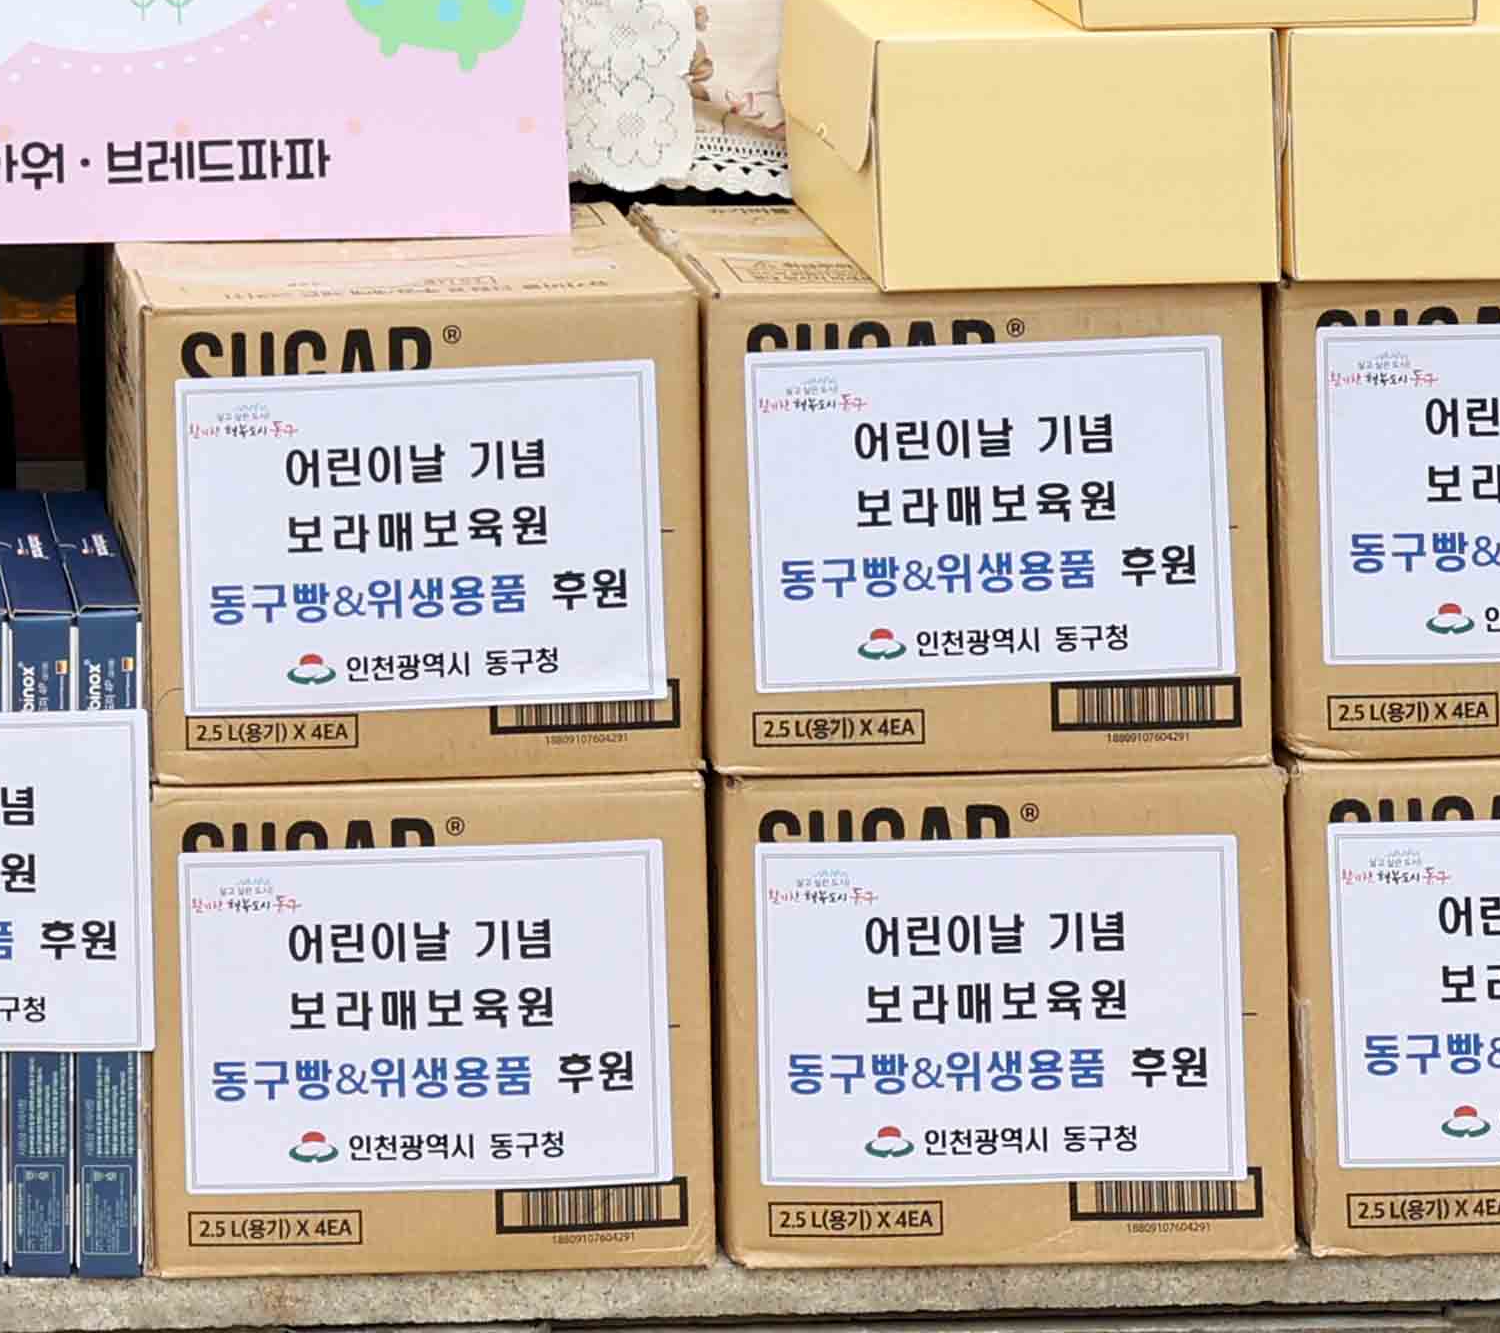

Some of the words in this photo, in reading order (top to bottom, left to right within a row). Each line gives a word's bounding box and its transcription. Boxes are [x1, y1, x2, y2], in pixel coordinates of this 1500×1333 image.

[107, 139, 330, 184] 브레드파파
[855, 418, 1013, 461] 어린이날
[1038, 414, 1112, 454] 기념
[286, 444, 445, 488] 어린이날
[471, 439, 544, 479] 기념
[858, 481, 1115, 527] 보라매보육원
[288, 506, 547, 553] 보라매보육원
[781, 550, 1094, 600] 동구빵&위생용품
[1122, 545, 1195, 586] 후원
[211, 575, 525, 625] 동구빵&위생용품
[552, 569, 627, 610] 후원
[917, 627, 1039, 656] 인천광역시
[1056, 625, 1128, 652] 동구청
[347, 652, 469, 681] 인천광역시
[486, 647, 558, 676] 동구청
[763, 720, 791, 738] 2.5
[859, 718, 873, 737] X
[877, 718, 915, 736] 4EA
[40, 921, 116, 960] 후원
[289, 922, 450, 963] 어린이날
[476, 919, 550, 960] 기념
[866, 914, 1024, 957] 어린이날
[1050, 912, 1124, 952] 기념
[291, 987, 552, 1030] 보라매보육원
[867, 980, 1126, 1024] 보라매보육원
[213, 1056, 531, 1101] 동구빵&위생용품
[559, 1051, 633, 1093] 후원
[788, 1049, 1104, 1094] 동구빵&위생용품
[1132, 1047, 1207, 1087] 후원
[349, 1134, 473, 1161] 인천광역시
[491, 1131, 564, 1159] 동구청
[925, 1127, 1047, 1155] 인천광역시
[1064, 1125, 1136, 1152] 동구청
[199, 1220, 226, 1238] 2.5
[296, 1219, 310, 1237] X
[314, 1219, 353, 1237] 4EA
[1357, 1201, 1385, 1220] 2.5
[1455, 1199, 1469, 1218] X
